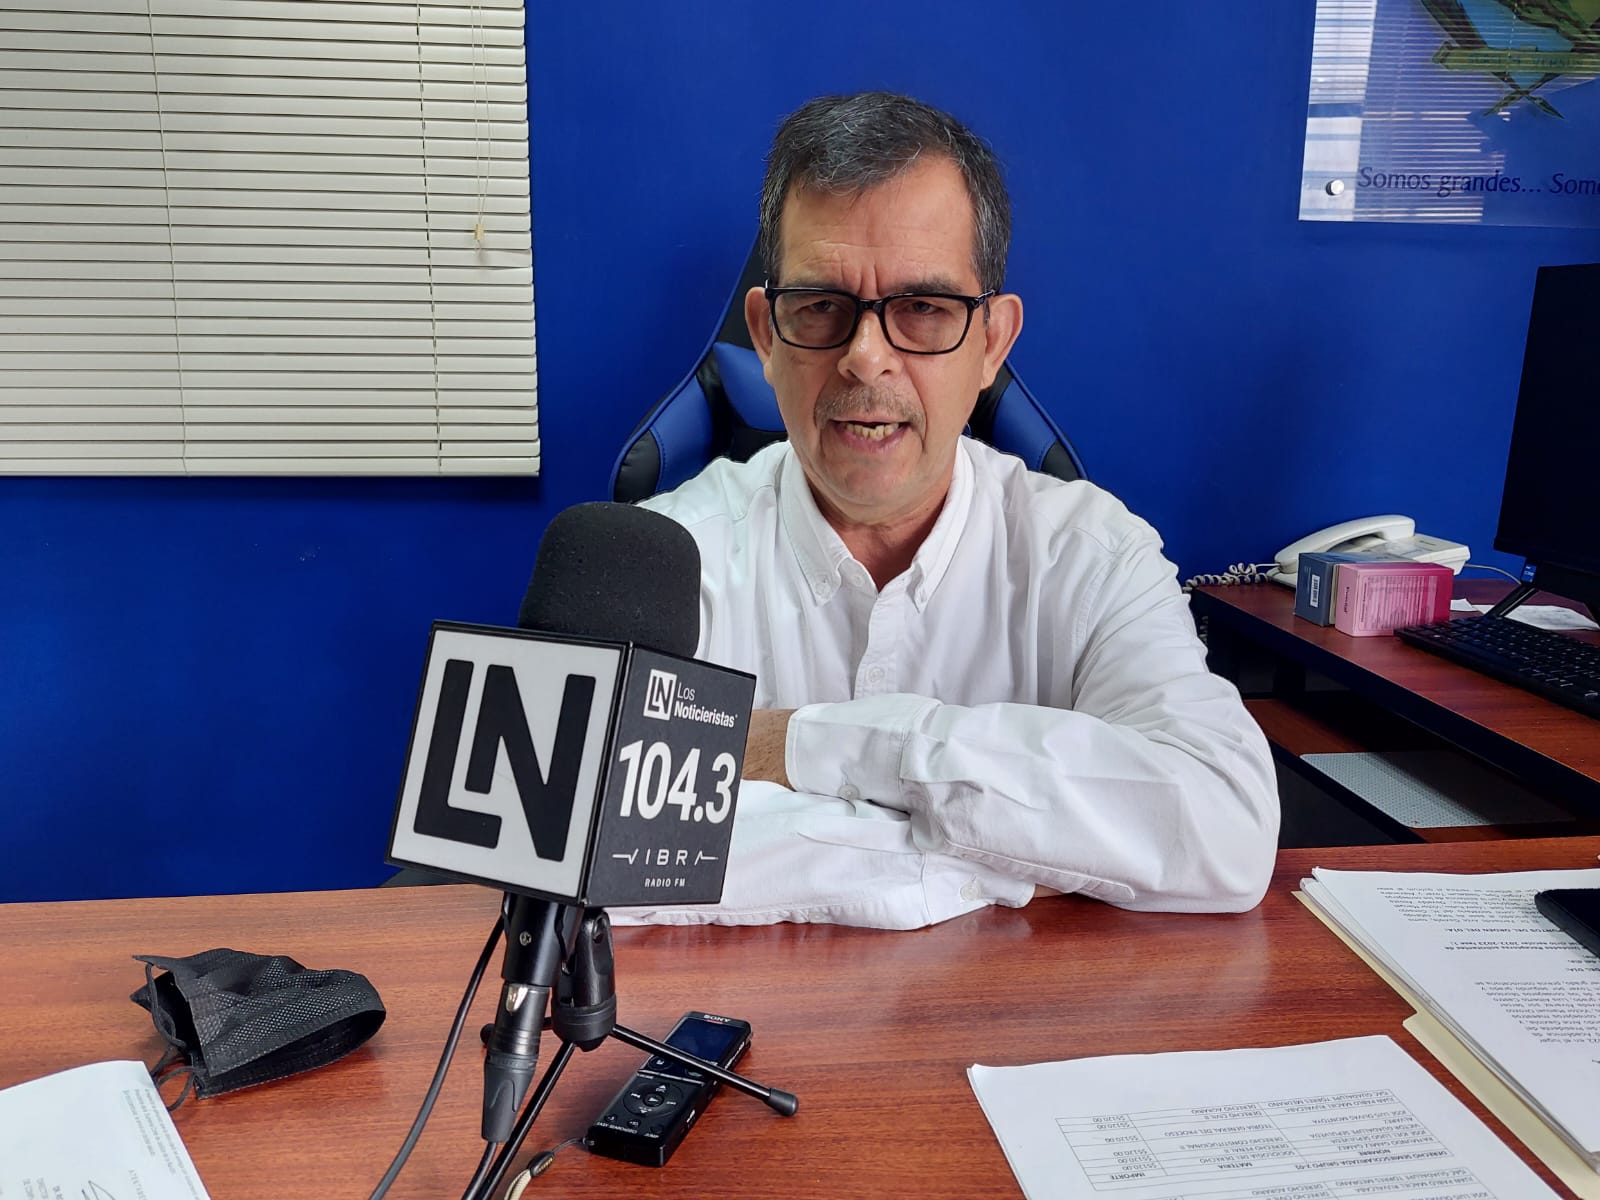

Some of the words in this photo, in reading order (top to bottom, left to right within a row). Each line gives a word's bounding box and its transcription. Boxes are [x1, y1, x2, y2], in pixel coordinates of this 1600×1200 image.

[1358, 166, 1431, 190] Somos
[1436, 169, 1541, 197] grandes...
[674, 700, 735, 729] Noticieristas
[619, 739, 736, 824] 104.3
[644, 877, 671, 888] RADIO
[675, 878, 686, 888] FM
[703, 1014, 731, 1023] SONY
